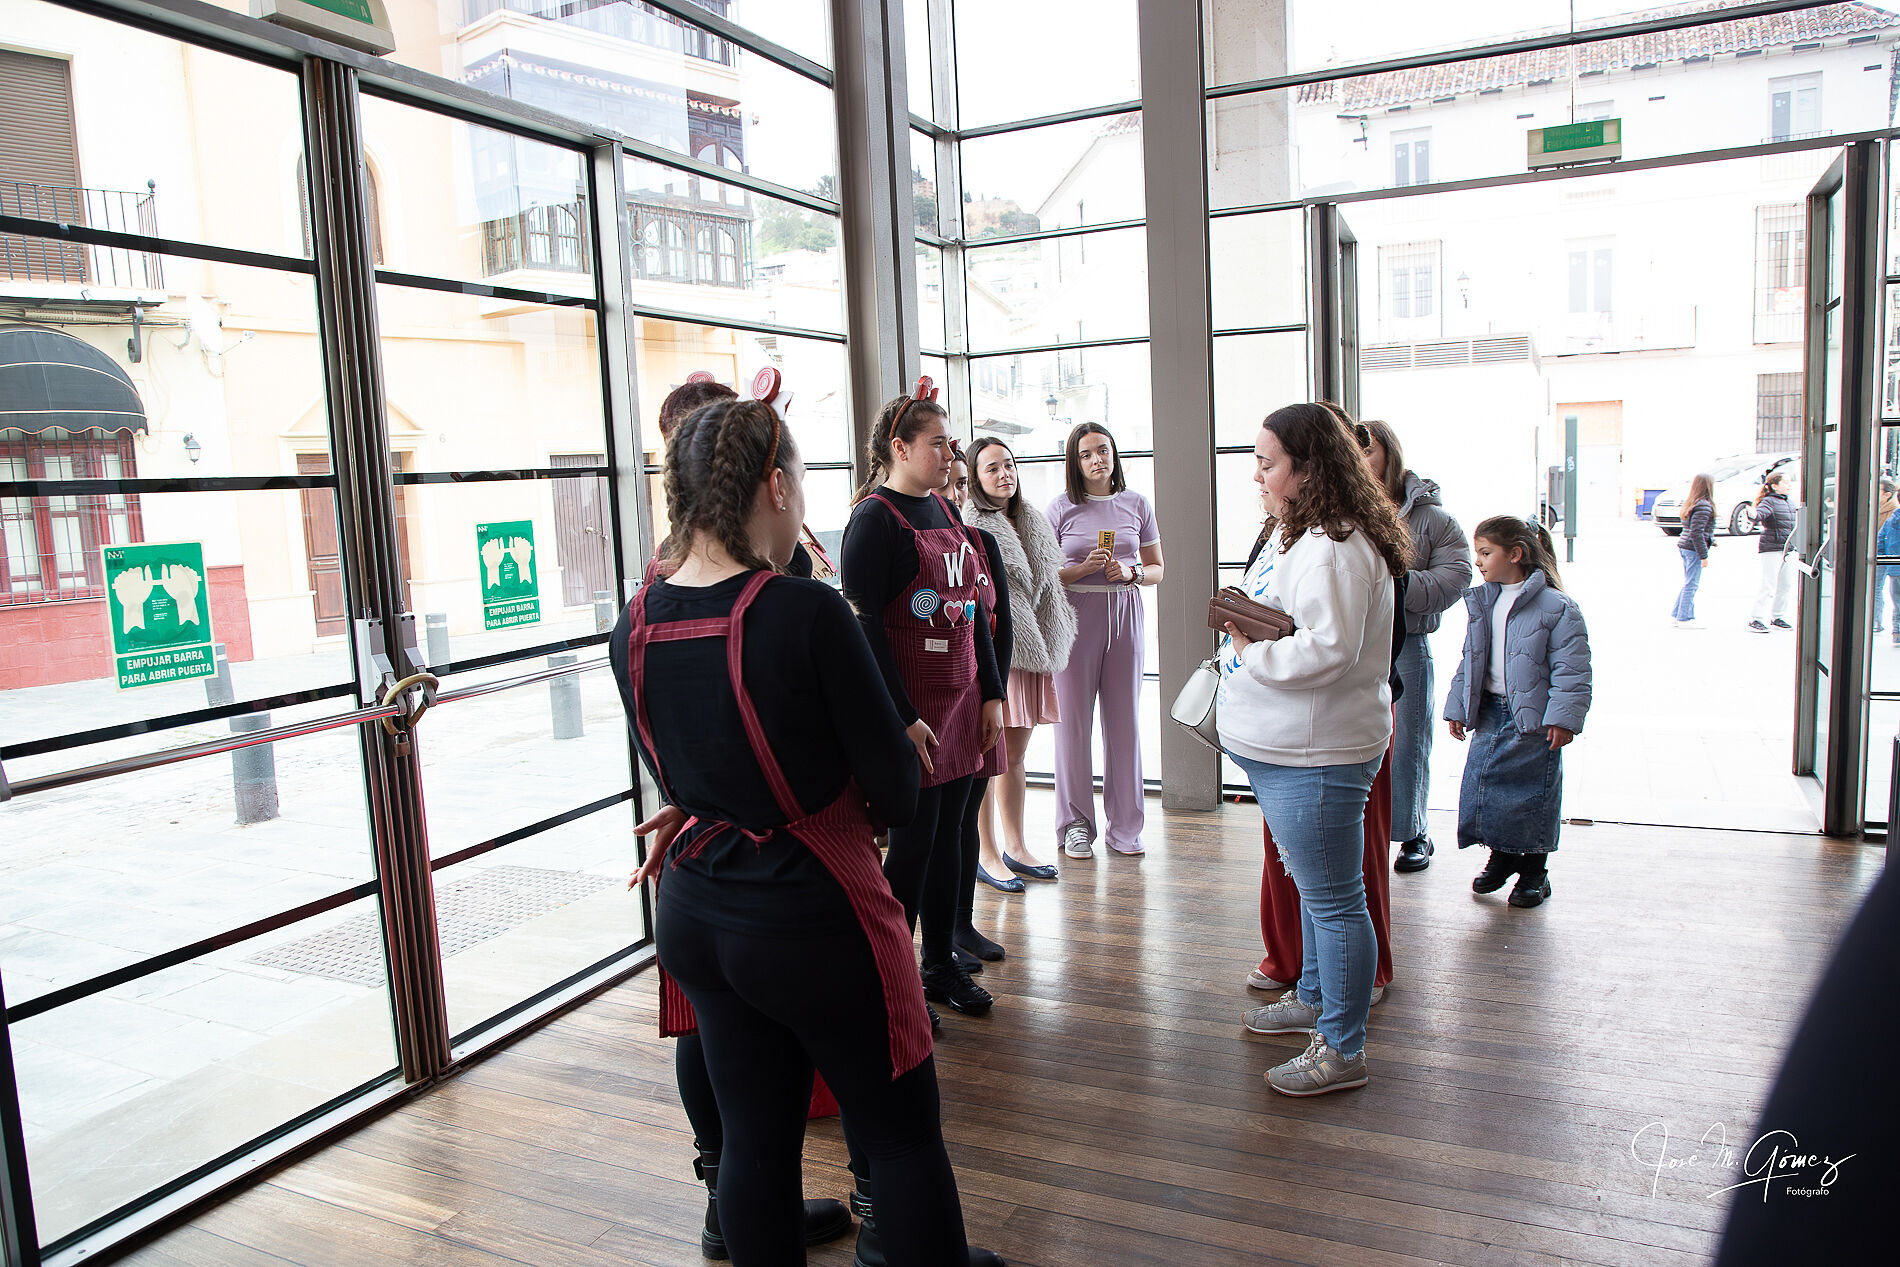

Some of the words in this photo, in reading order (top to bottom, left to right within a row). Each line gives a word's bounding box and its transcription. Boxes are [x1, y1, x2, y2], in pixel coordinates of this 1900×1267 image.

[1103, 531, 1112, 548] TICKET
[489, 606, 516, 617] EMPUJAR
[516, 602, 535, 612] BARRA
[486, 618, 501, 628] PARA
[502, 615, 518, 625] ABRIR
[519, 612, 540, 622] PUERTA
[126, 655, 172, 670] EMPUJAR
[174, 650, 204, 663] BARRA
[121, 672, 147, 685] PARA
[149, 667, 176, 681] ABRIR
[178, 662, 212, 677] PUERTA
